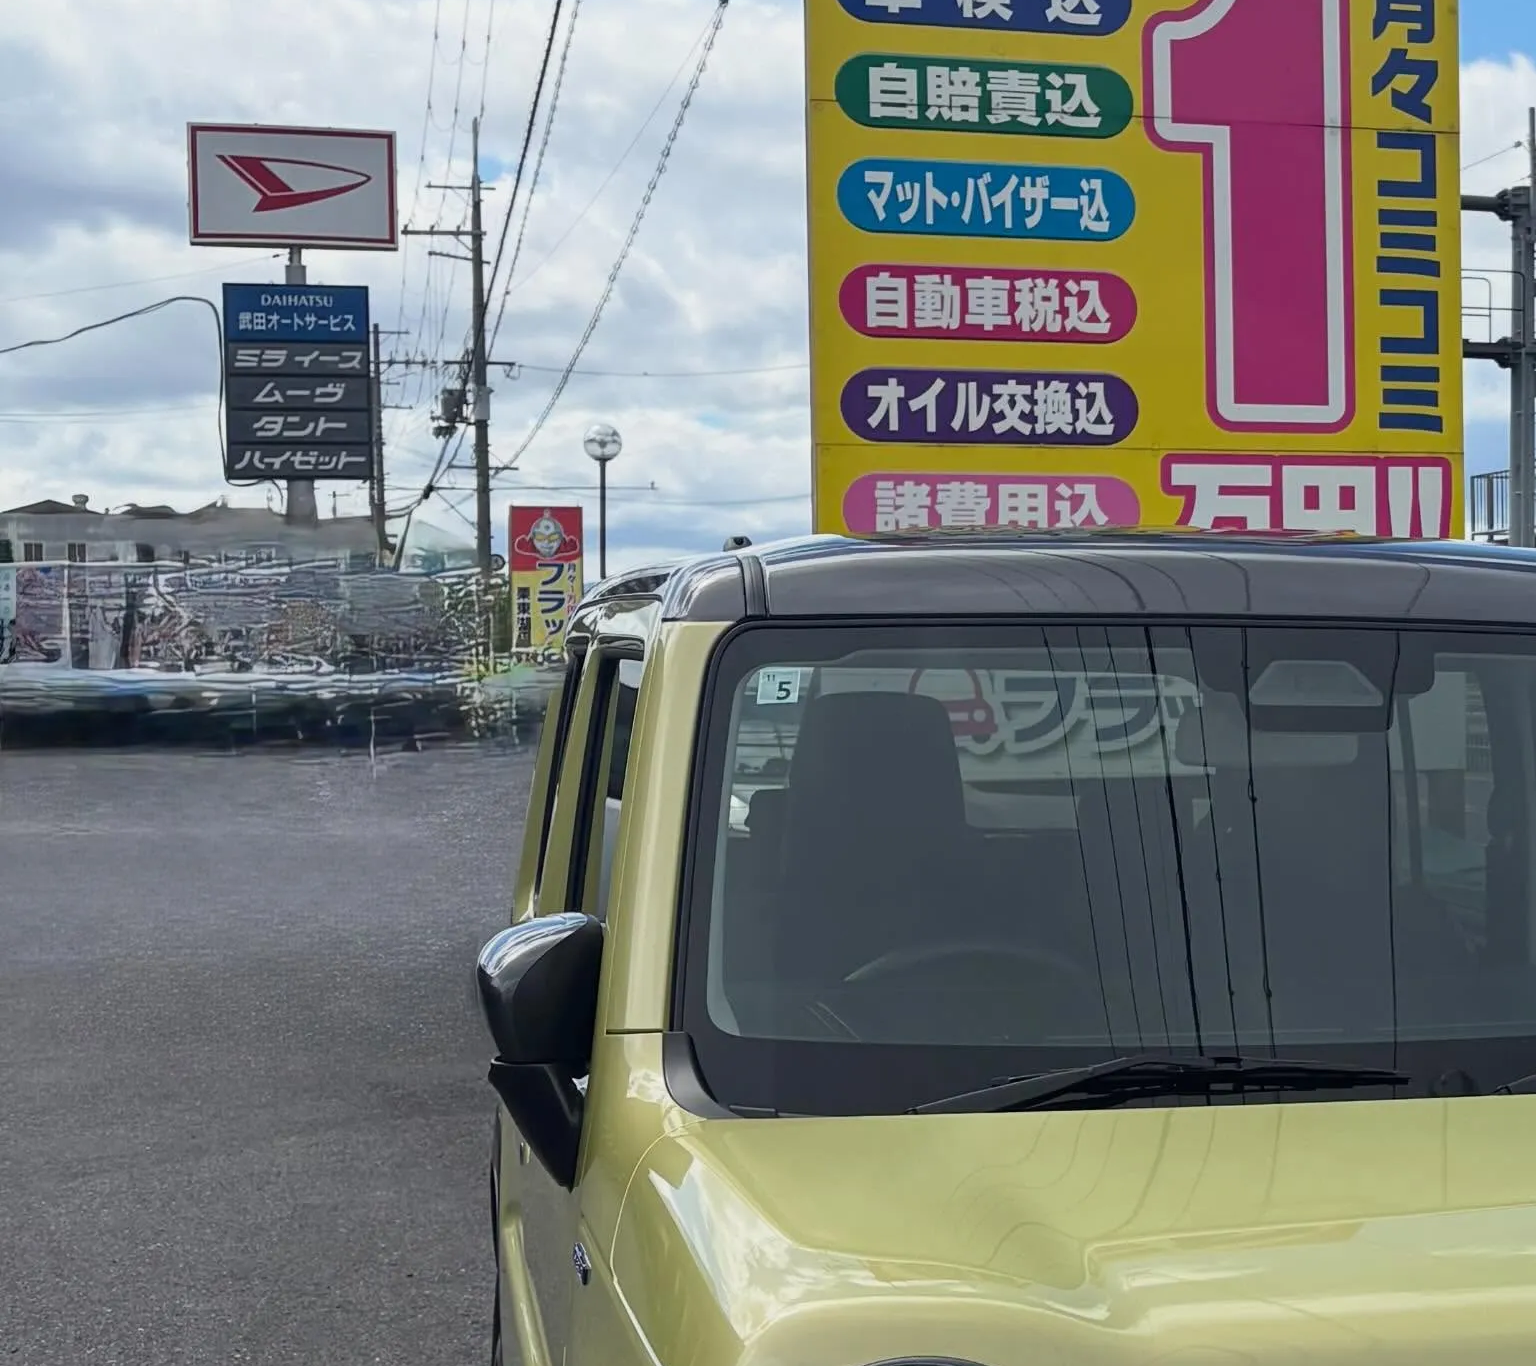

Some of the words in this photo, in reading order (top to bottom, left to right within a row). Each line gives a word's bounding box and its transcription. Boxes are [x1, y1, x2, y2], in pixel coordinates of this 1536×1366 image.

[868, 62, 1102, 128] 自賠責込
[261, 294, 333, 307] DAIHATSU
[865, 272, 1112, 334] 自動車税込
[238, 312, 356, 332] 武田オートサービス
[252, 382, 346, 403] ムーヴ
[867, 378, 1115, 436] オイル交換込
[252, 416, 347, 437] タント
[234, 451, 366, 470] ハイゼット
[874, 480, 1110, 529] 諸費用込
[776, 681, 792, 701] 5
